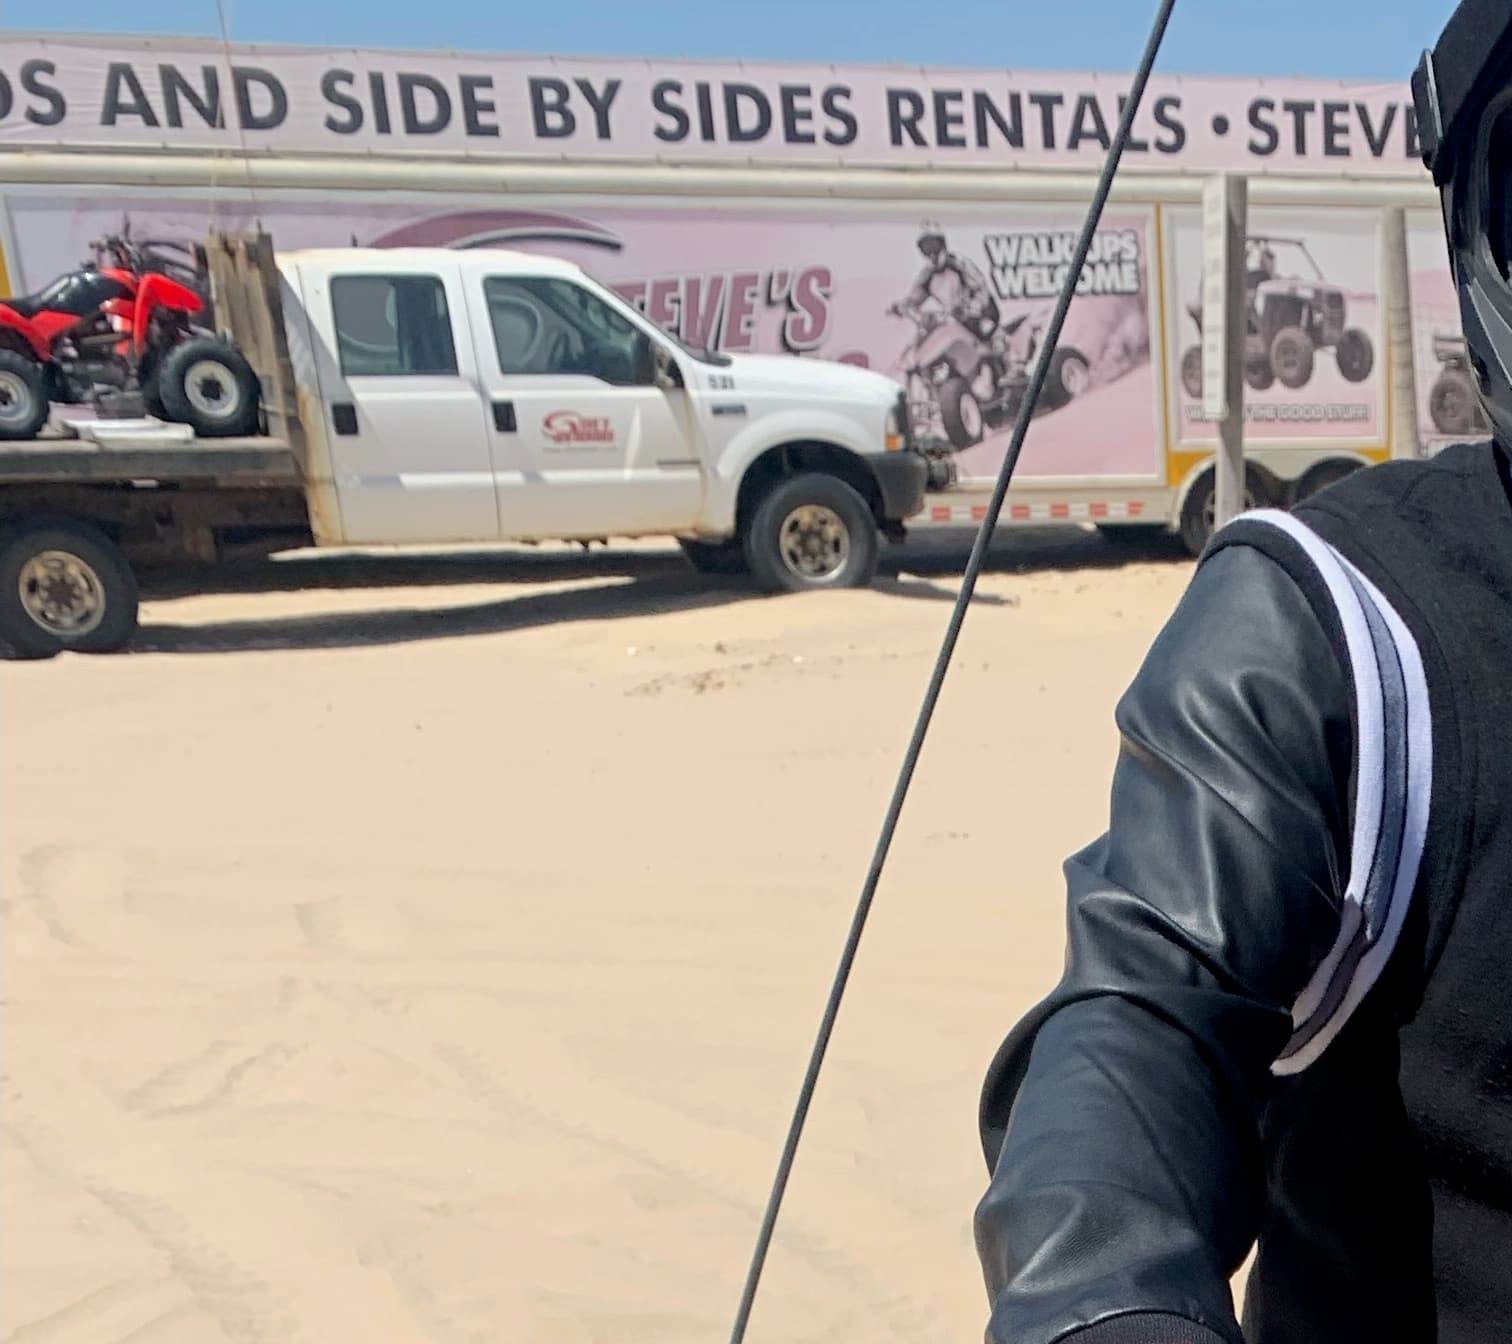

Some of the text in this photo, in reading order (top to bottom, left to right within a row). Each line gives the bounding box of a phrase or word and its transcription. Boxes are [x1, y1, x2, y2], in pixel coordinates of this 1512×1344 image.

[0, 59, 67, 127] S
[101, 62, 288, 130] AND
[324, 69, 502, 138] SIDE
[528, 77, 622, 141] BY
[652, 79, 858, 146] SIDES
[885, 86, 1187, 154] RENTALS
